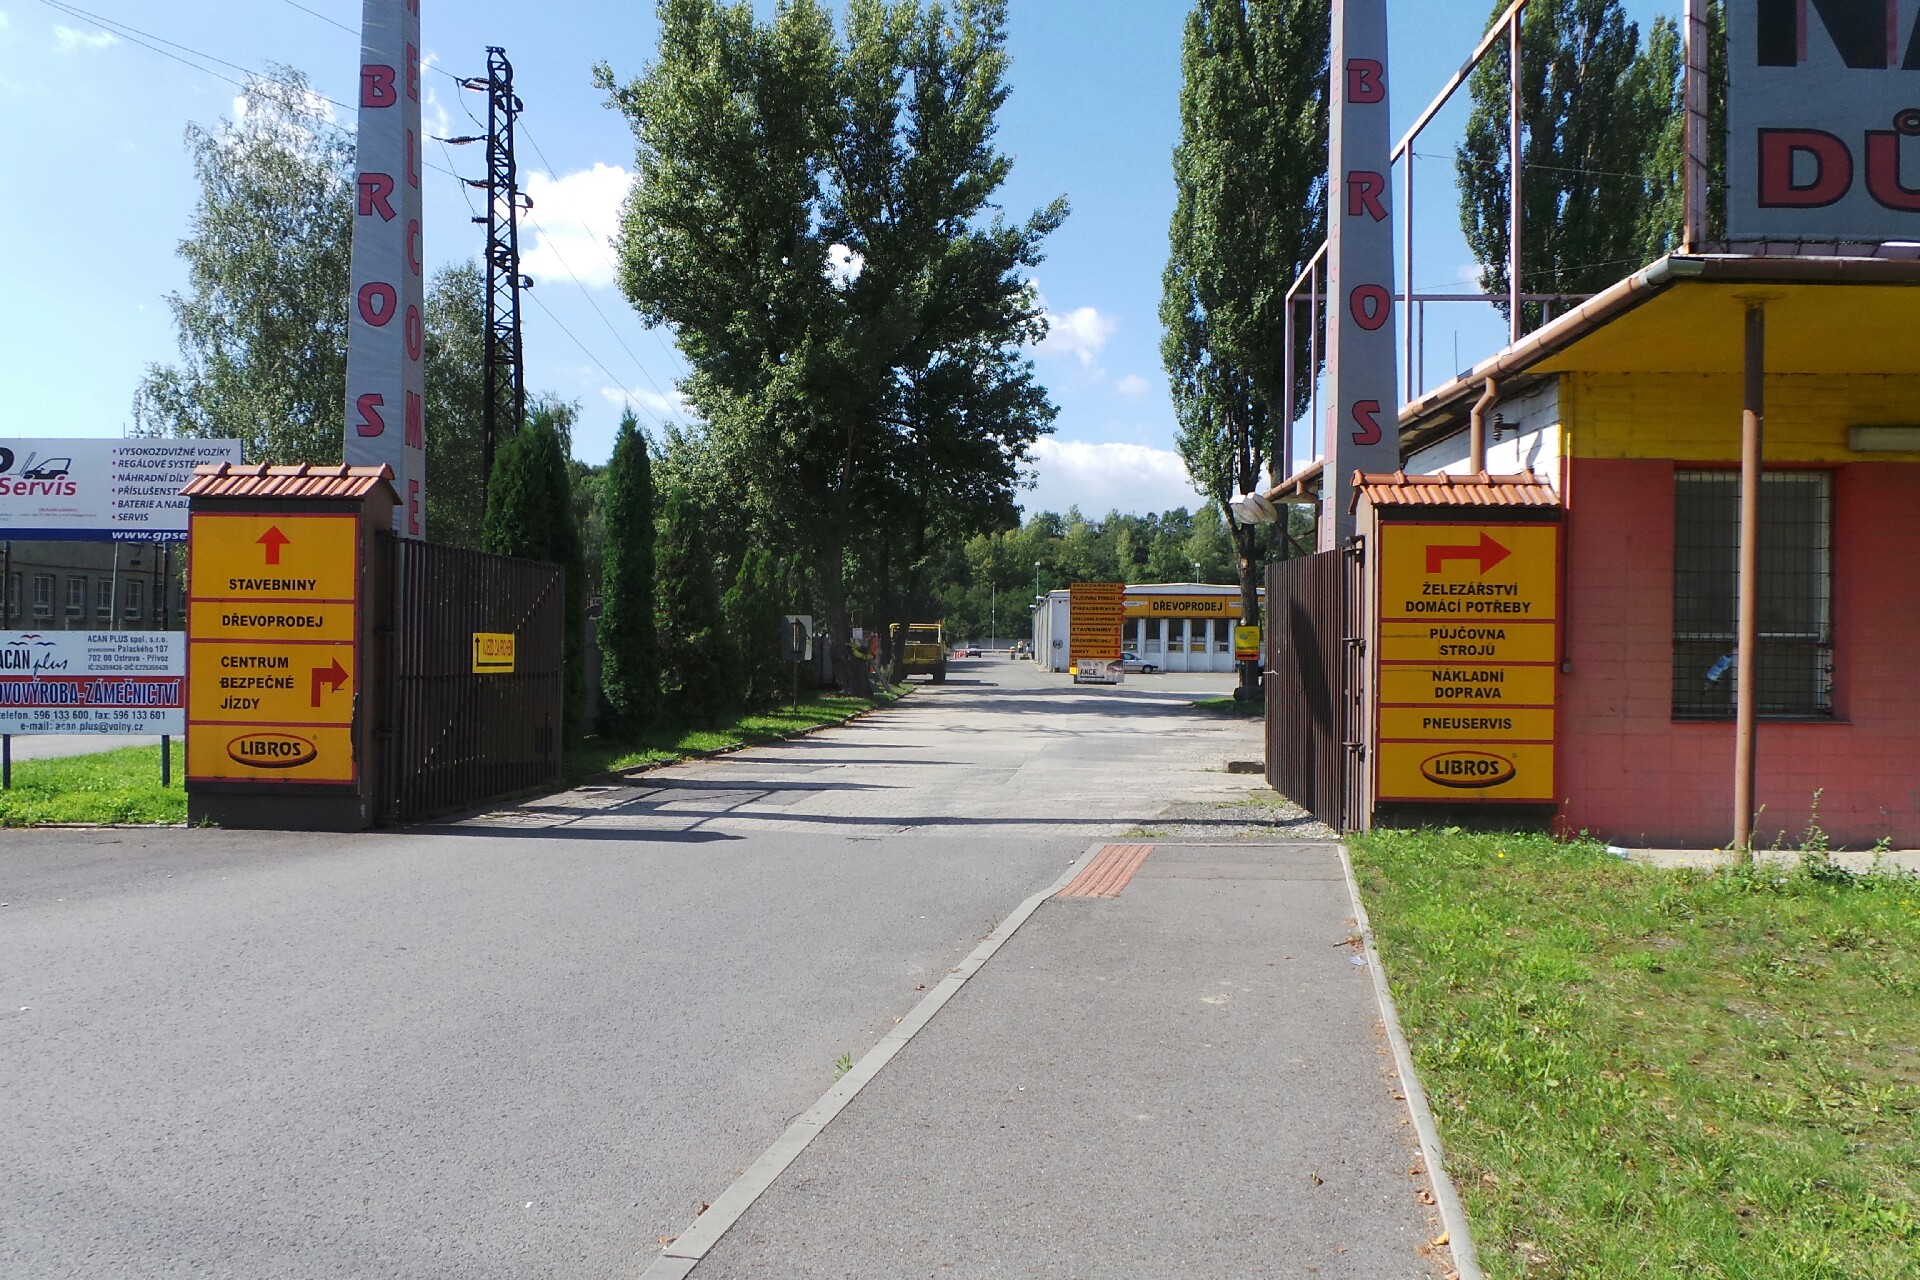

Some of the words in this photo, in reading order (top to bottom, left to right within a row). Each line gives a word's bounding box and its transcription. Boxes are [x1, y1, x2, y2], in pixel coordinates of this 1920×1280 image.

[119, 447, 196, 456] VYSOKOZDVIŽNÉ
[197, 447, 231, 456] VOZÍKY
[118, 459, 166, 468] REGÁLOVÉ
[118, 473, 168, 482] NÁHRADNÍ
[169, 473, 190, 482] DÍLY
[118, 499, 154, 509] BATERIE
[155, 500, 163, 509] A
[118, 513, 149, 521] SERVIS
[229, 578, 317, 591] STAVEBNINY
[1422, 581, 1519, 596] ŽELEZÁŘSTVÍ
[1153, 600, 1223, 611] DŘEVOPRODEJ
[1405, 599, 1461, 614] DOMÁCÍ
[1465, 599, 1531, 614] POTŘEBY
[222, 613, 323, 628] DŘEVOPRODEJ
[1429, 625, 1506, 640] PŮJČOVNA
[87, 635, 107, 643] ACAN
[110, 635, 128, 643] PLUS
[117, 645, 153, 653] Palackého
[155, 645, 168, 653] 107
[1439, 642, 1495, 656] STROJŮ
[88, 654, 101, 662] 702
[103, 654, 112, 662] 00
[114, 654, 140, 662] Ostrava
[220, 656, 289, 669] CENTRUM
[33, 651, 68, 678] plus
[220, 674, 294, 689] BEZPEČNÉ
[1432, 668, 1504, 683] NÁKLADNÍ
[1434, 687, 1502, 699] DOPRAVA
[220, 696, 261, 710] JÍZDY
[33, 710, 51, 720] 596
[53, 710, 70, 720] 133
[113, 710, 129, 720] 596
[132, 710, 147, 720] 133
[150, 710, 166, 720] 601
[20, 721, 52, 731] e-mail:
[1423, 718, 1512, 730] PNEUSERVIS
[240, 741, 301, 757] LIBROS
[1435, 760, 1500, 776] LIBROS
